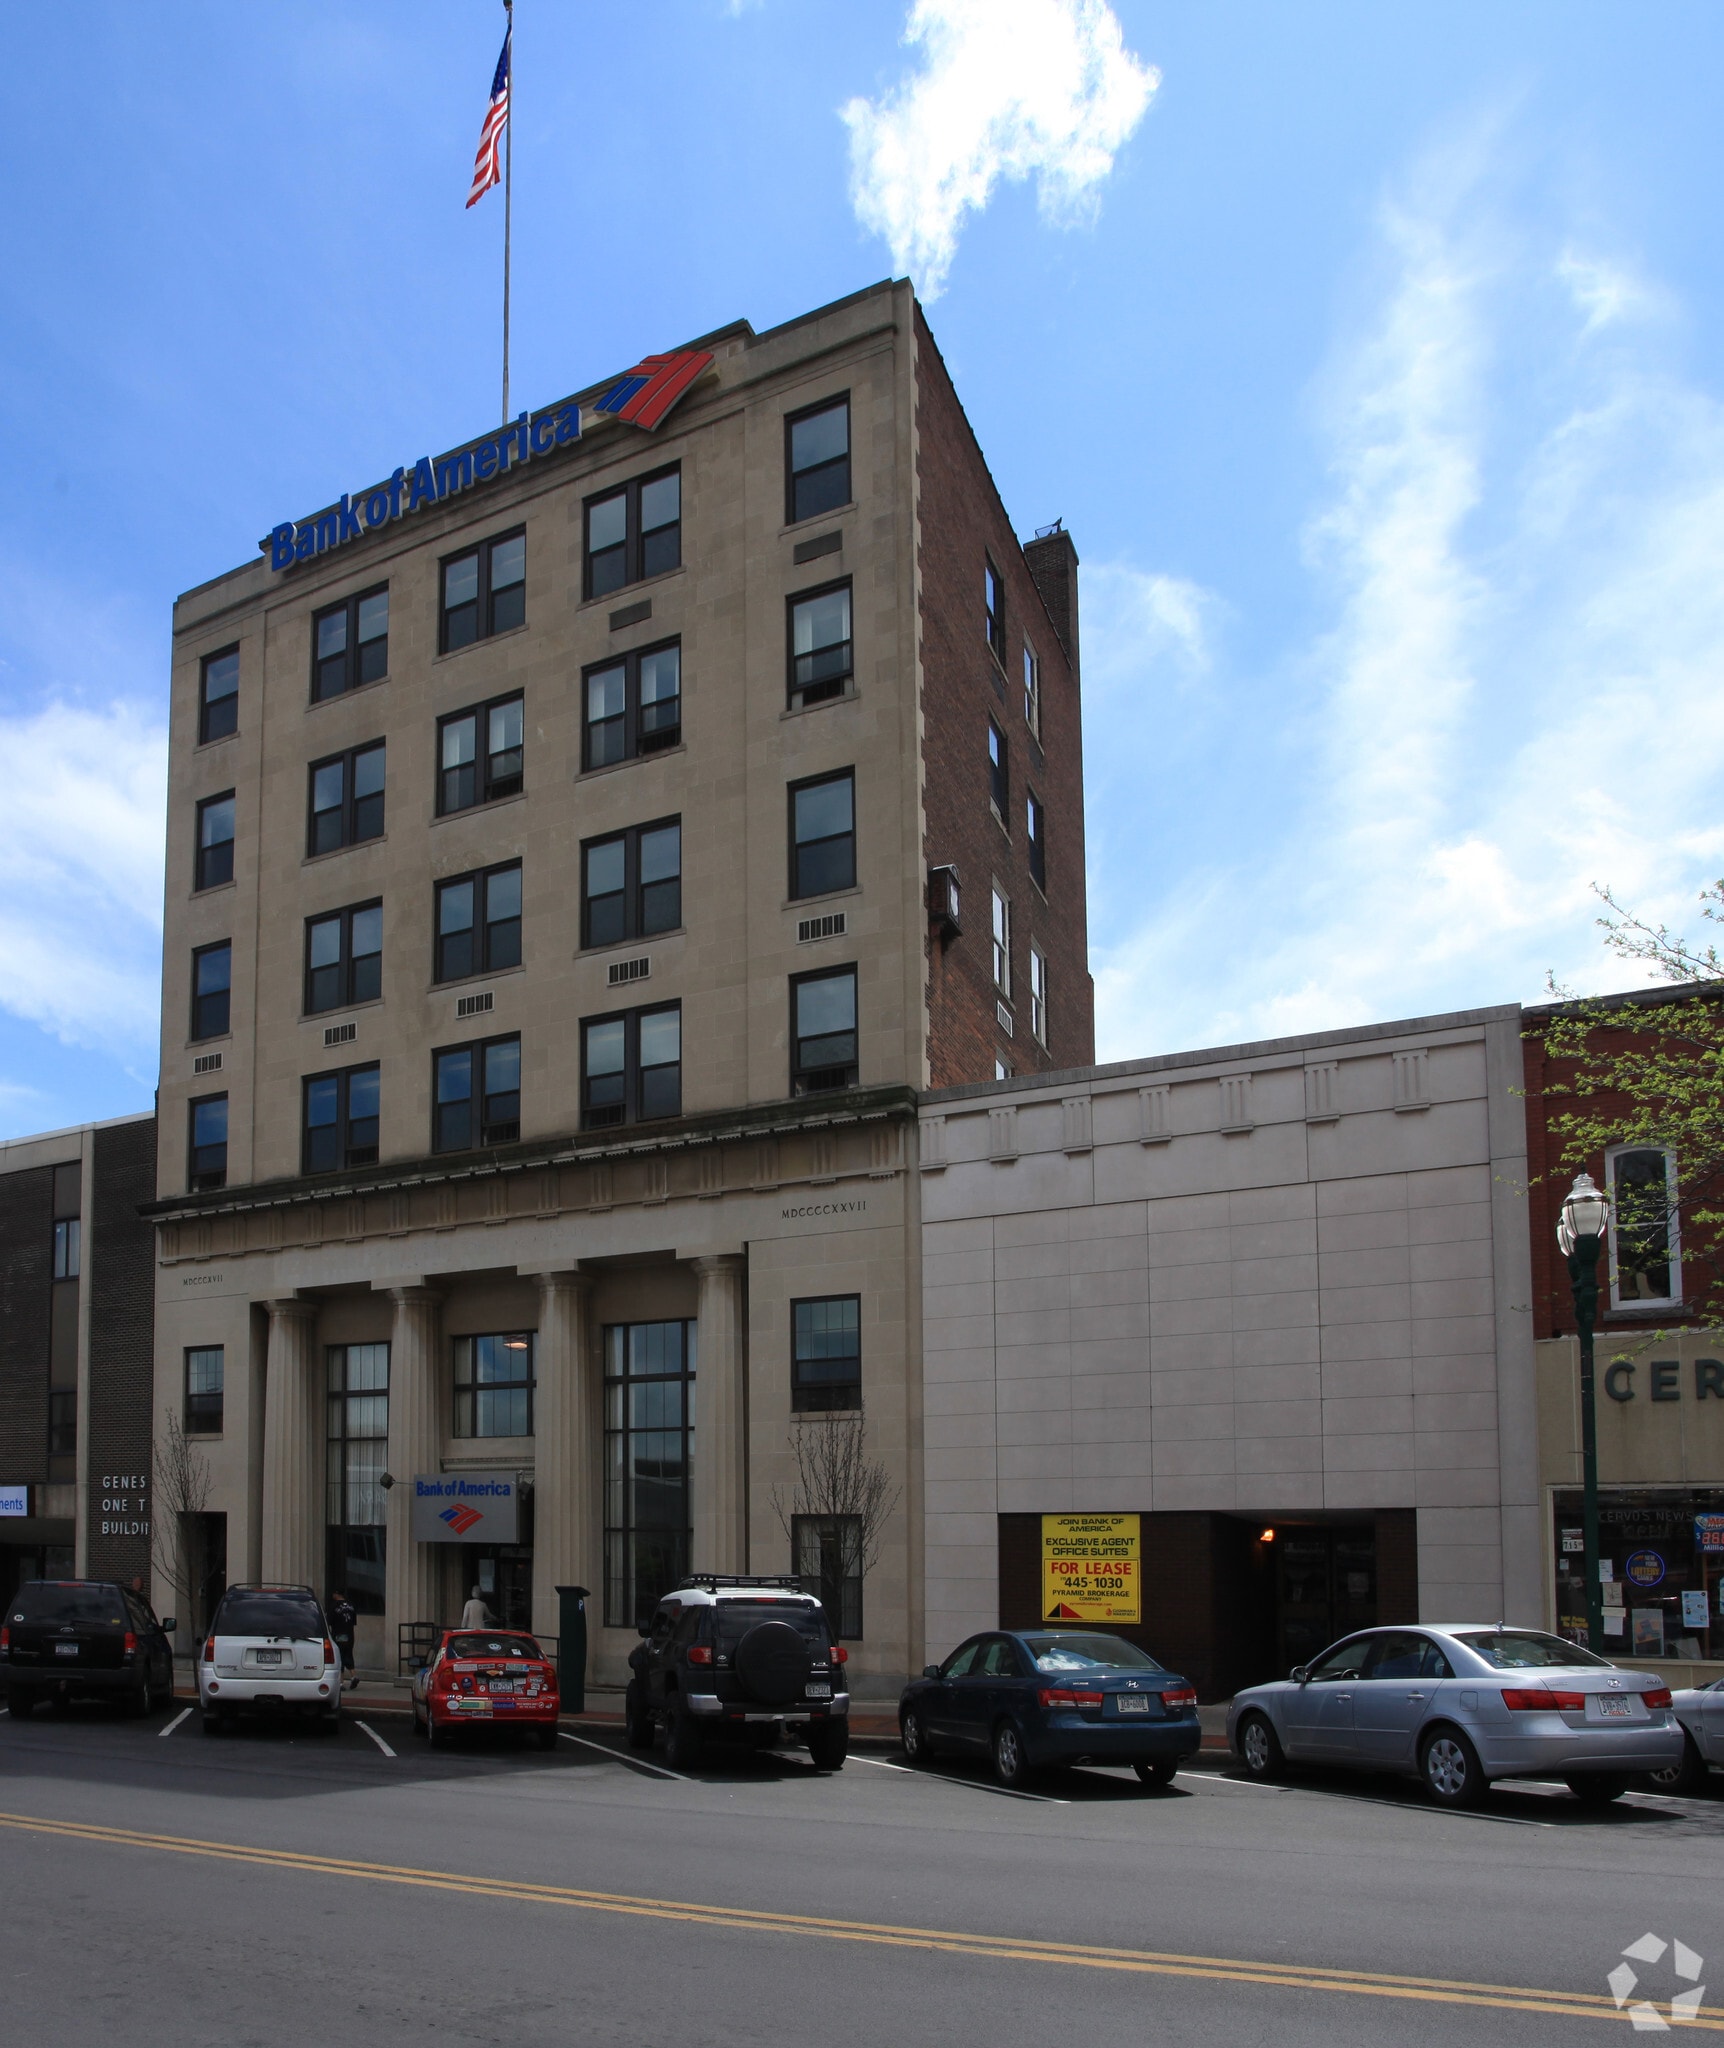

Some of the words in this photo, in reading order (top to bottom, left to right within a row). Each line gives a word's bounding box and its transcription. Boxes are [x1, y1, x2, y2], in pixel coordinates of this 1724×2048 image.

[271, 492, 364, 573] Bank
[364, 466, 407, 530] of
[408, 402, 584, 511] America
[781, 1200, 866, 1219] MDCCCCXXVII
[1604, 1358, 1724, 1402] CER
[102, 1475, 146, 1489] GENES
[416, 1480, 444, 1497] Bank
[444, 1480, 457, 1496] of
[457, 1480, 511, 1497] America
[102, 1499, 128, 1512] ONE
[1656, 1510, 1694, 1522] NEWS
[1045, 1537, 1099, 1546] EXCLUSIVE
[1101, 1537, 1135, 1546] AGENT
[1052, 1547, 1089, 1556] OFFICE
[1090, 1547, 1129, 1556] SUITES
[1051, 1562, 1079, 1575] FOR
[1085, 1562, 1132, 1575] LEASE
[1631, 1566, 1660, 1576] LOTTERY
[1064, 1576, 1123, 1589] 445-1030
[1052, 1589, 1085, 1597] PYRAMID
[1087, 1589, 1130, 1598] BROKERAGE
